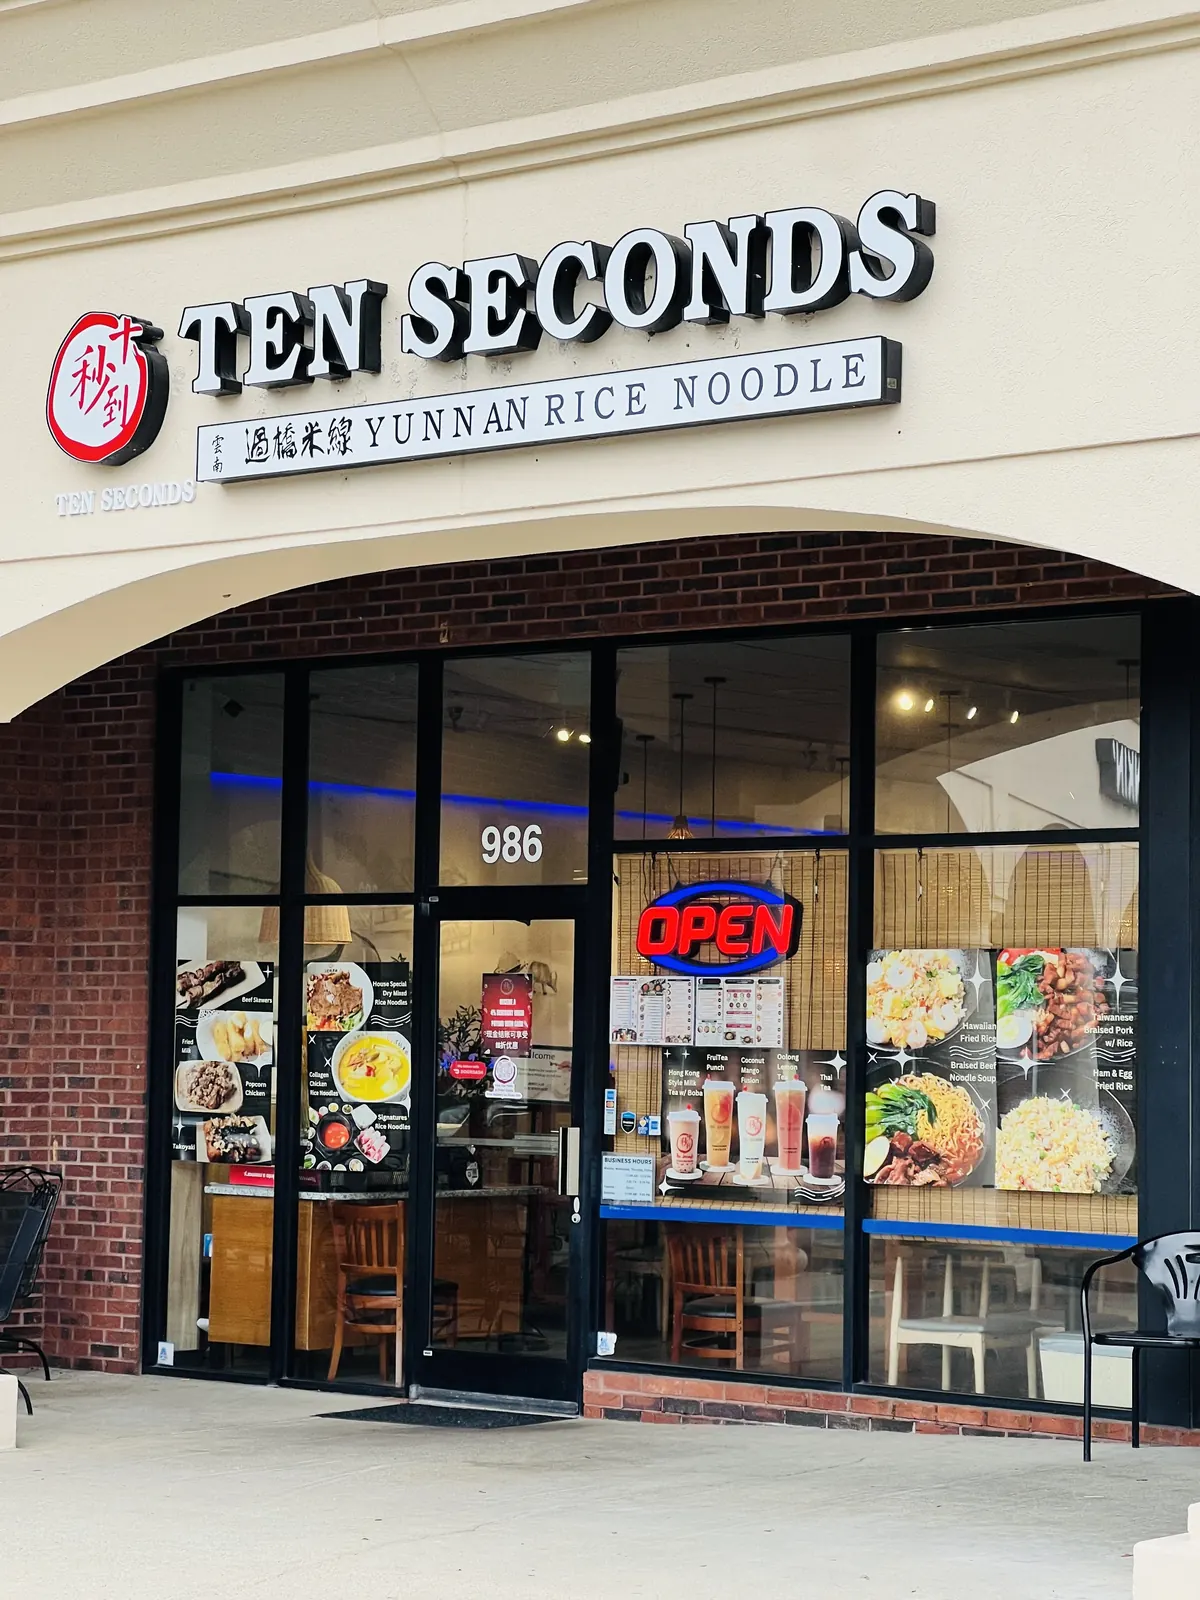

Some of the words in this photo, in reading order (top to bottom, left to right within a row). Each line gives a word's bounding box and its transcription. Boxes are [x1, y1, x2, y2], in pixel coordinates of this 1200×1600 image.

[179, 279, 387, 396] TEN
[401, 189, 936, 362] SECONDS
[364, 395, 529, 448] YUNNAN
[545, 382, 647, 428] RICE
[672, 352, 867, 410] NOODLE
[244, 415, 353, 464] 過橋米線
[211, 434, 225, 473] 雲南
[55, 489, 96, 517] TEN
[101, 480, 196, 511] SECONDS
[481, 824, 543, 864] 986
[636, 904, 795, 956] OPEN
[390, 981, 407, 989] Special
[383, 990, 393, 998] Dry
[1093, 1013, 1134, 1021] Taiwanese
[962, 1022, 997, 1030] Hawaiian
[1084, 1026, 1114, 1034] Braised
[1115, 1026, 1134, 1034] Pork
[960, 1034, 980, 1042] Fried
[981, 1034, 997, 1043] Rice
[1105, 1038, 1115, 1047] w/
[1116, 1039, 1133, 1047] Rice
[777, 1053, 799, 1062] Oolong
[951, 1061, 978, 1069] Braised
[980, 1061, 997, 1070] Beef
[668, 1069, 684, 1077] Hong
[684, 1069, 700, 1077] Kong
[741, 1067, 760, 1075] Mango
[1093, 1069, 1110, 1077] Ham
[1112, 1069, 1118, 1077] &
[1118, 1069, 1133, 1080] Egg
[950, 1074, 977, 1082] Noodle
[977, 1074, 997, 1084] Soup
[245, 1081, 267, 1089] Popcorn
[668, 1080, 683, 1088] Style
[1096, 1082, 1115, 1090] Fried
[1116, 1082, 1133, 1090] Rice
[687, 1089, 703, 1097] Boba
[378, 1114, 408, 1122] Signatures
[173, 1143, 196, 1151] Takoyaki
